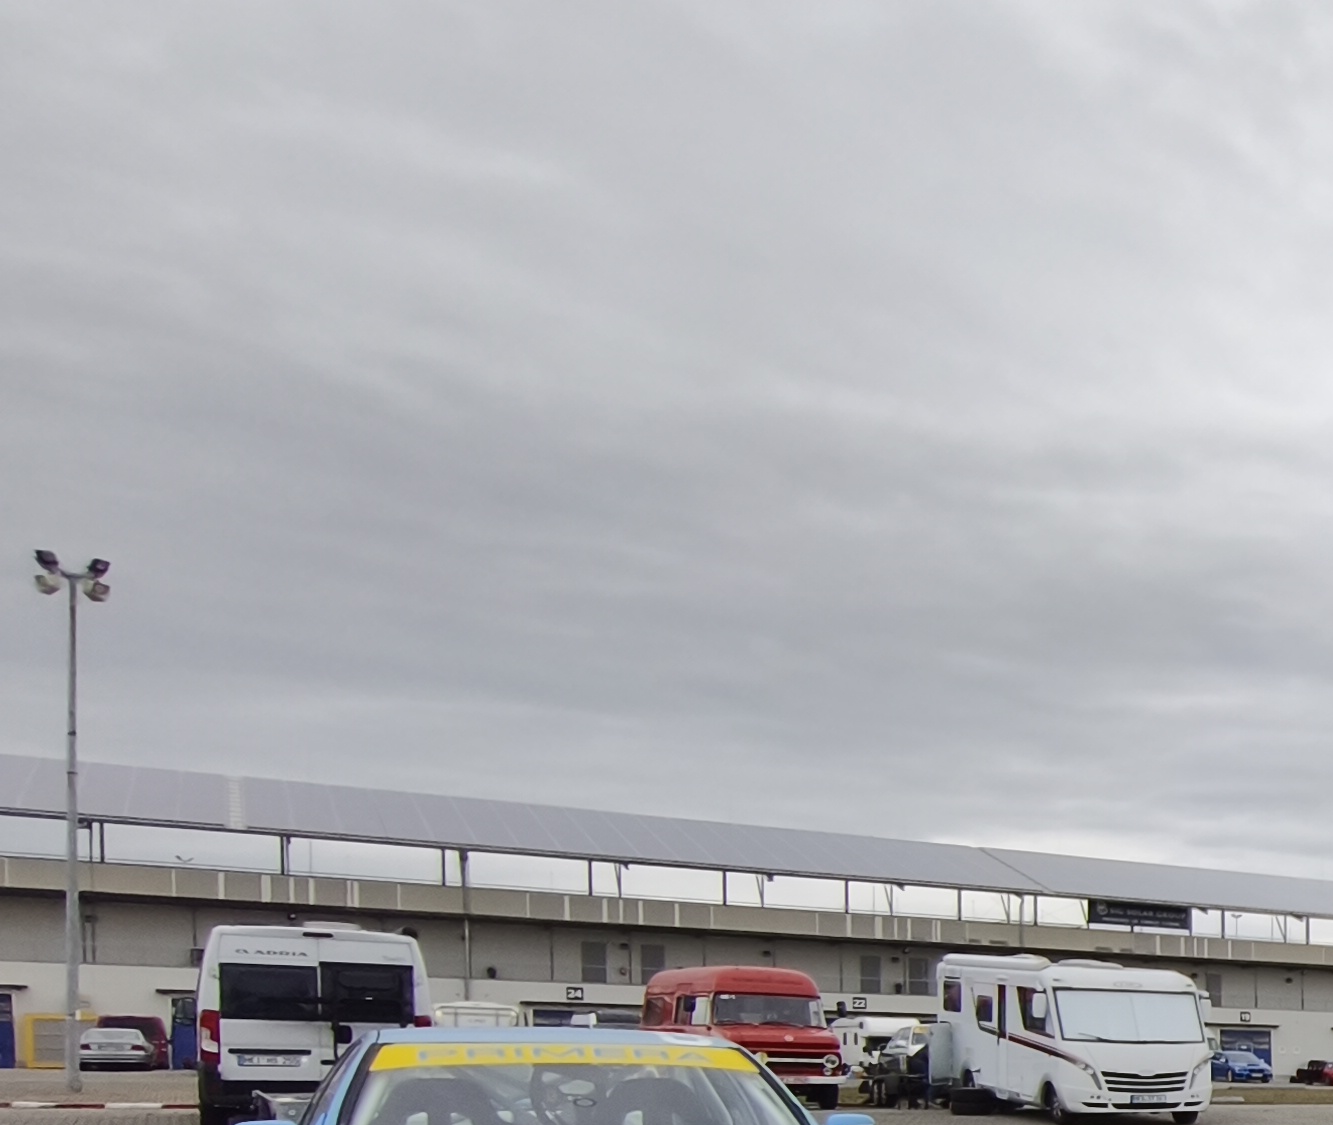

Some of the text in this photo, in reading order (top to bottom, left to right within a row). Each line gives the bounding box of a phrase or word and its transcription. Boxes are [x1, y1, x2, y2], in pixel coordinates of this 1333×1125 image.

[253, 949, 308, 958] ADRIA
[567, 987, 583, 1000] 24
[853, 999, 866, 1009] 22
[418, 1044, 712, 1065] PRIMERA
